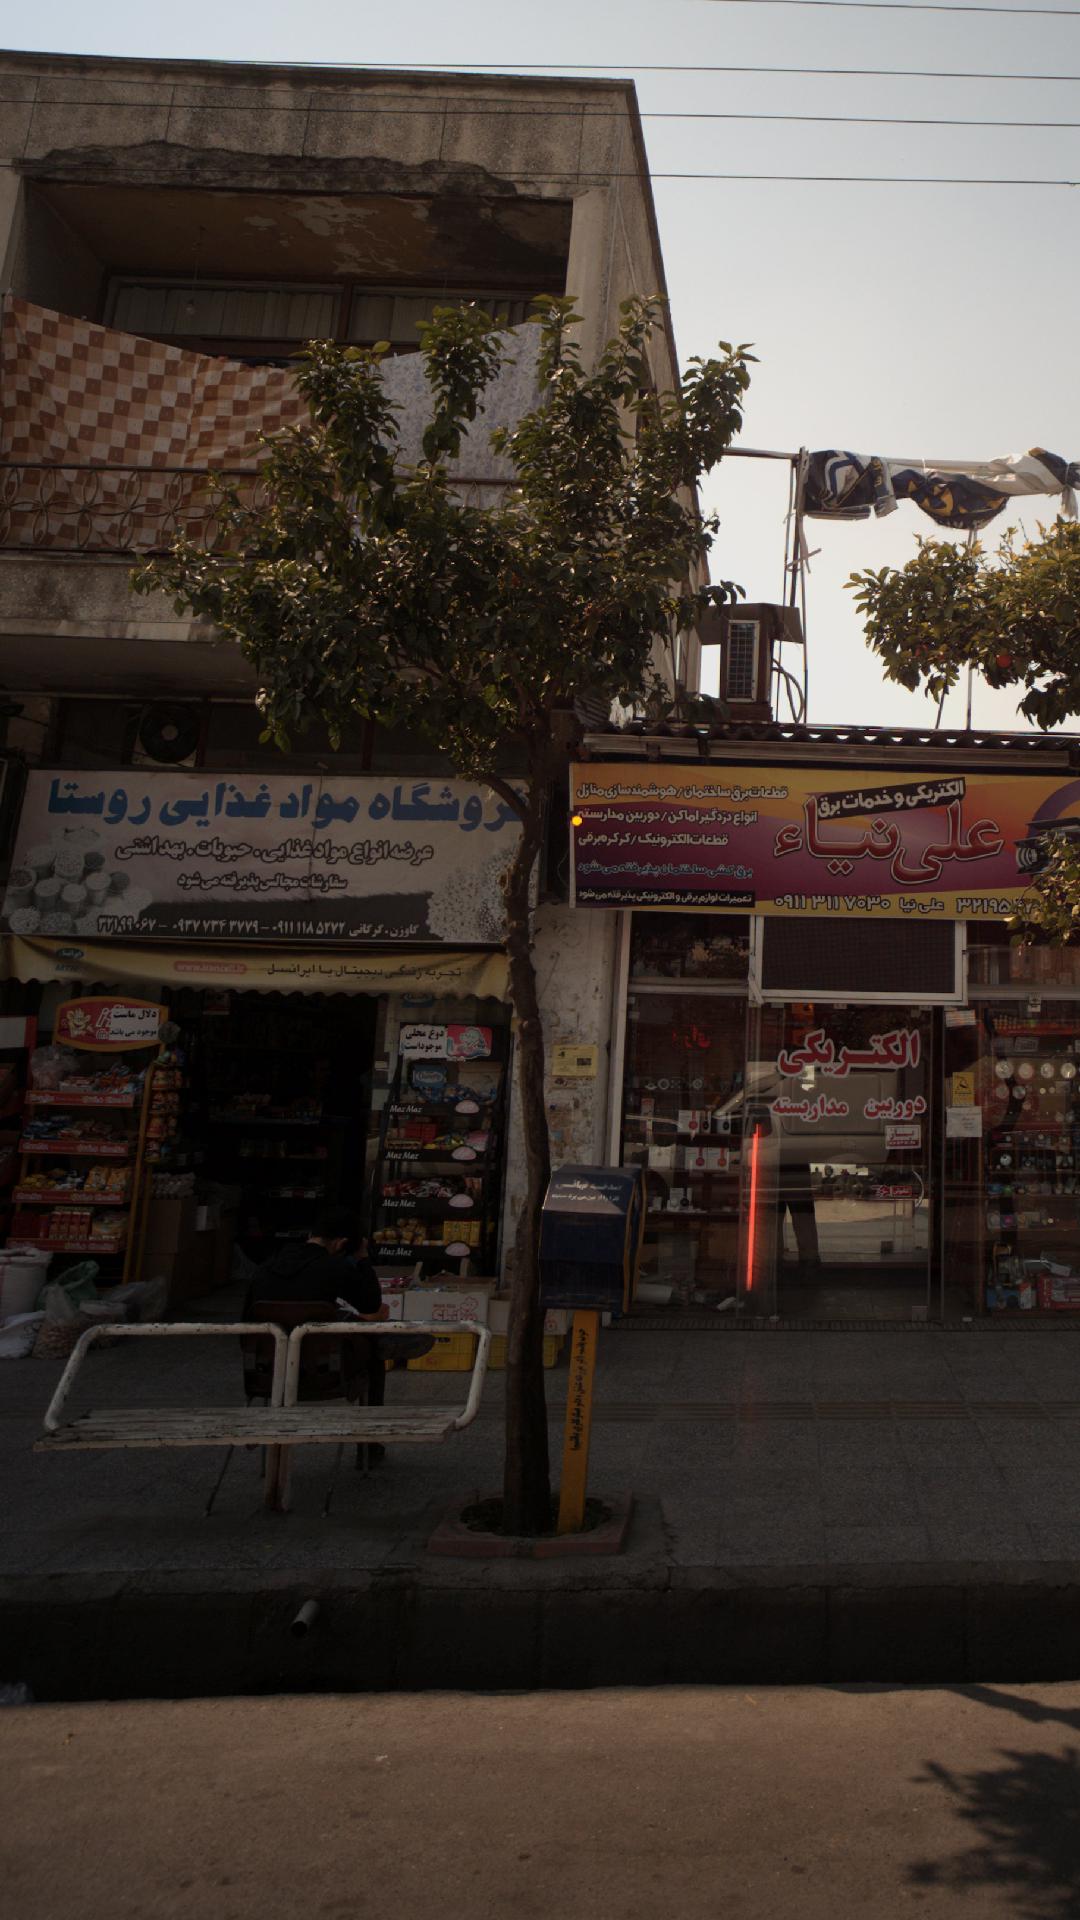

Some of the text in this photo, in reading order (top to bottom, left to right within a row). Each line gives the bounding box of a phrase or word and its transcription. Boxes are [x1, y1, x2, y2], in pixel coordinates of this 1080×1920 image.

[577, 783, 604, 799] منازل
[683, 784, 730, 799] ساختمان
[730, 785, 749, 801] برق
[749, 785, 789, 799] قطعات
[816, 779, 965, 818] الکتریکی و خدمات برق
[48, 779, 152, 825] روستا
[159, 781, 272, 827] غذایی
[279, 783, 361, 829] مواد
[625, 810, 660, 824] دوربین
[668, 808, 699, 824] اماکن
[699, 808, 732, 825] دزدگیر
[733, 810, 758, 826] انواع
[637, 833, 690, 848] الکترونیک
[690, 833, 729, 846] قطعات
[891, 799, 1004, 885] علی
[115, 836, 186, 861] بهداشتی
[313, 839, 348, 864] مواد
[348, 839, 390, 866] انواع
[390, 841, 434, 866] عرضه
[177, 871, 200, 891] شود
[220, 871, 259, 892] پذیرفته
[259, 872, 299, 892] مجالس
[299, 873, 348, 892] سفارشات
[718, 892, 752, 904] تعمیرات
[774, 894, 806, 910] ۰۹۱۱
[812, 895, 840, 910] ۳۱۱
[845, 895, 890, 911] ۷۰۳۰
[899, 897, 918, 912] نیا
[918, 897, 945, 913] علی
[267, 962, 315, 977] ایرانسل
[318, 963, 333, 978] با
[335, 964, 383, 979] دیجیتال
[113, 1009, 136, 1018] ماست
[405, 1027, 444, 1040] دوغ محلی
[778, 1029, 921, 1077] الکتریکی
[863, 1095, 926, 1119] دوربین
